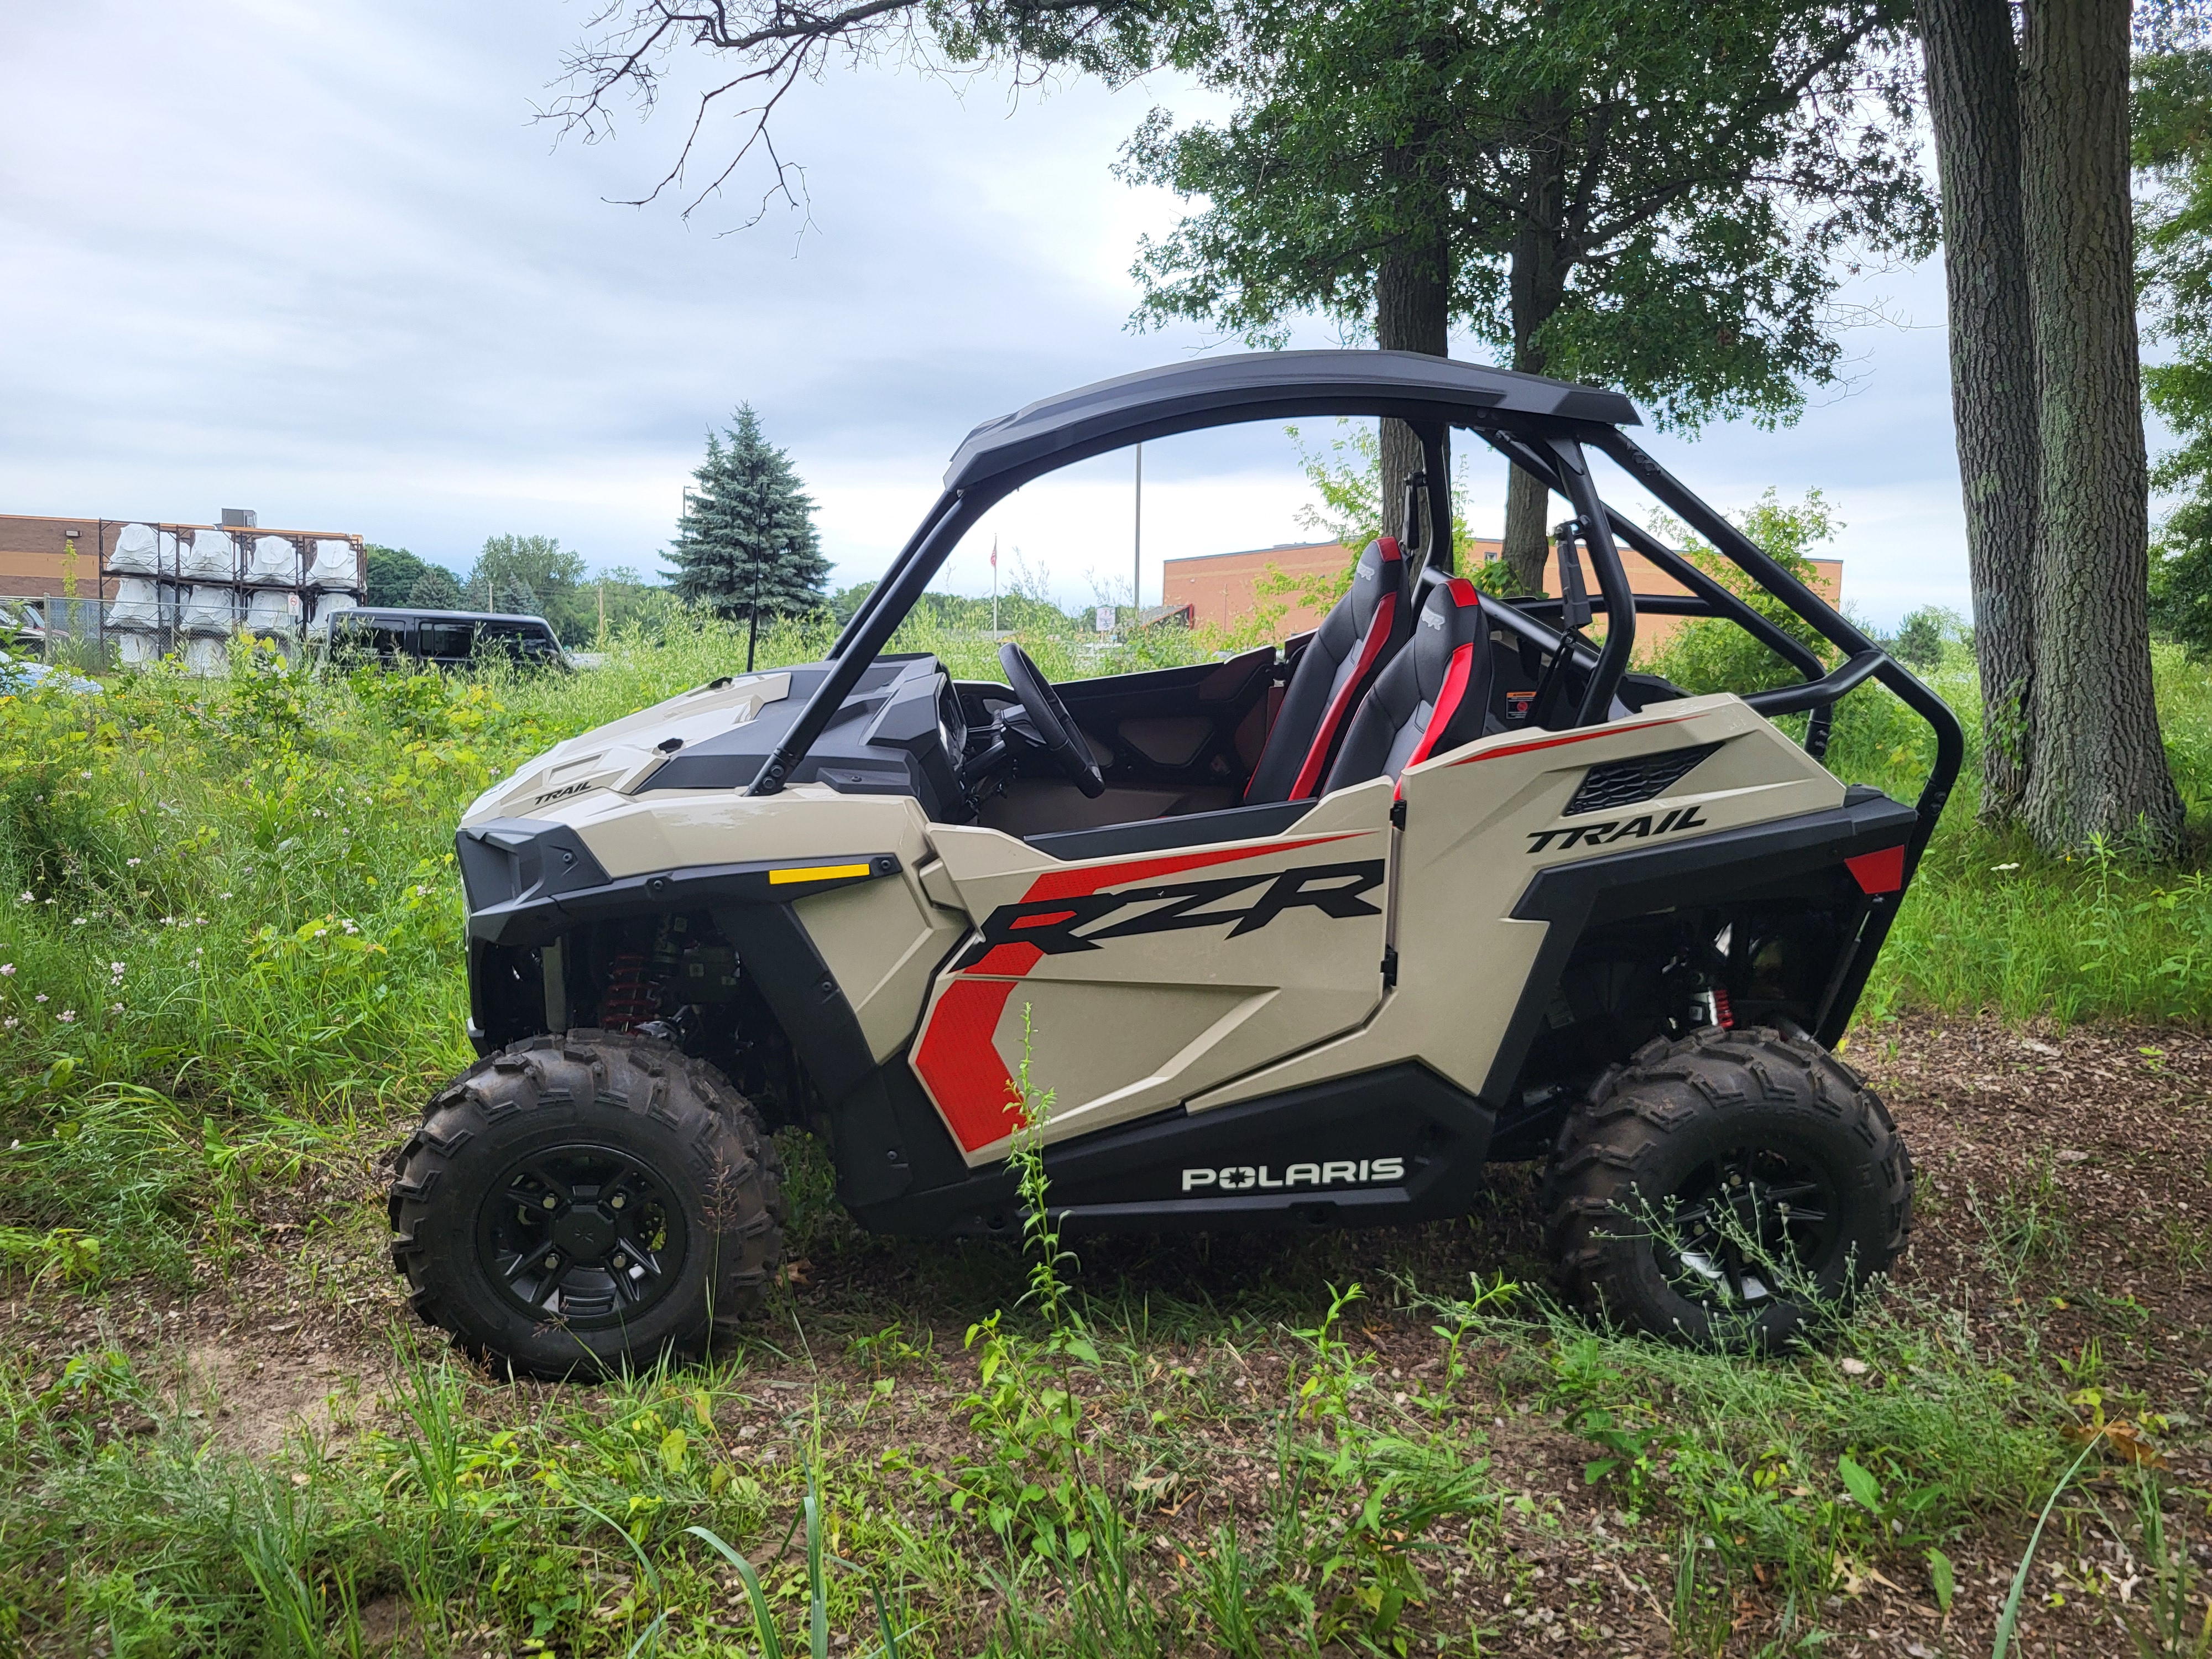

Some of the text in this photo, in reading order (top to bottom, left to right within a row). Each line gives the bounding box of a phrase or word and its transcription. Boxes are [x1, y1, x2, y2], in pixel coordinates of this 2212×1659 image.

[535, 781, 592, 806] TRAIL
[1526, 806, 1708, 854] TRAIL
[947, 858, 1386, 973] RZR
[1182, 1157, 1405, 1191] POLARIS
